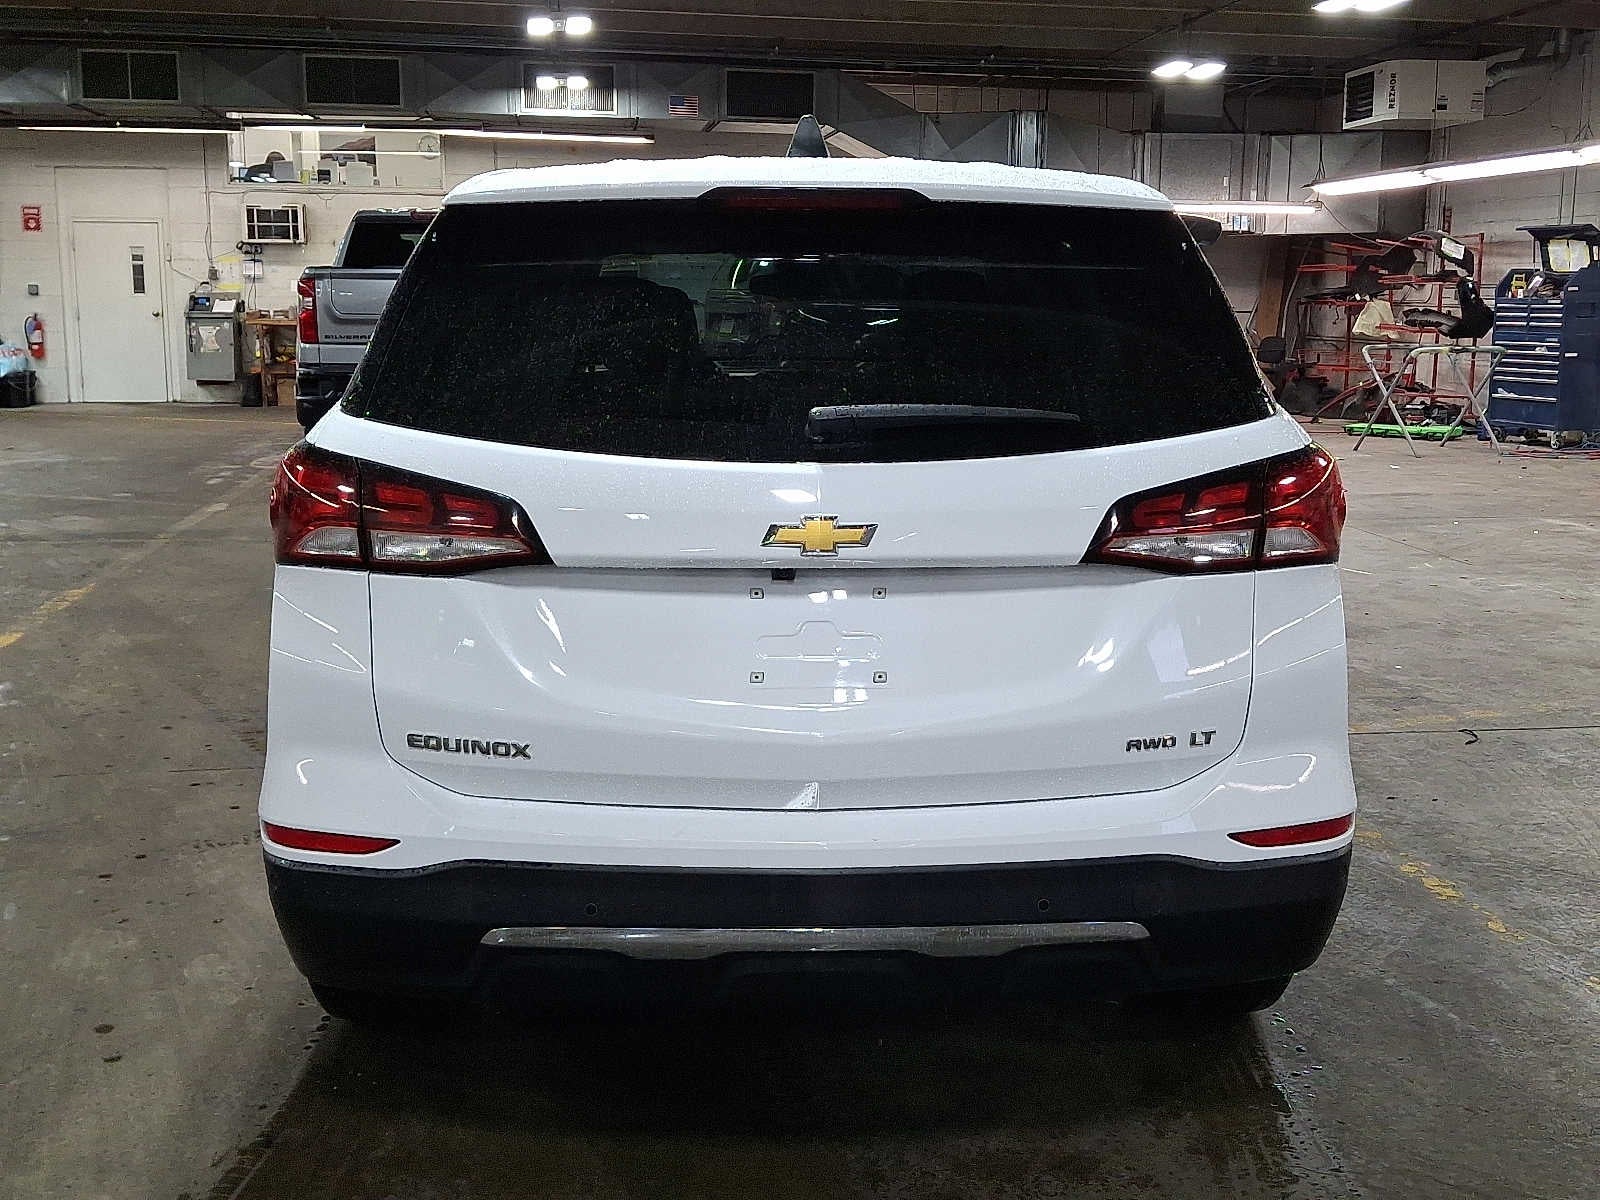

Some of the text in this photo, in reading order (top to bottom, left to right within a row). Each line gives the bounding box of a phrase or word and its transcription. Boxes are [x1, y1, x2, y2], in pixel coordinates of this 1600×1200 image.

[1388, 72, 1397, 109] REZNOR
[406, 733, 532, 760] EQUINOX
[1125, 729, 1217, 752] AWD LT
